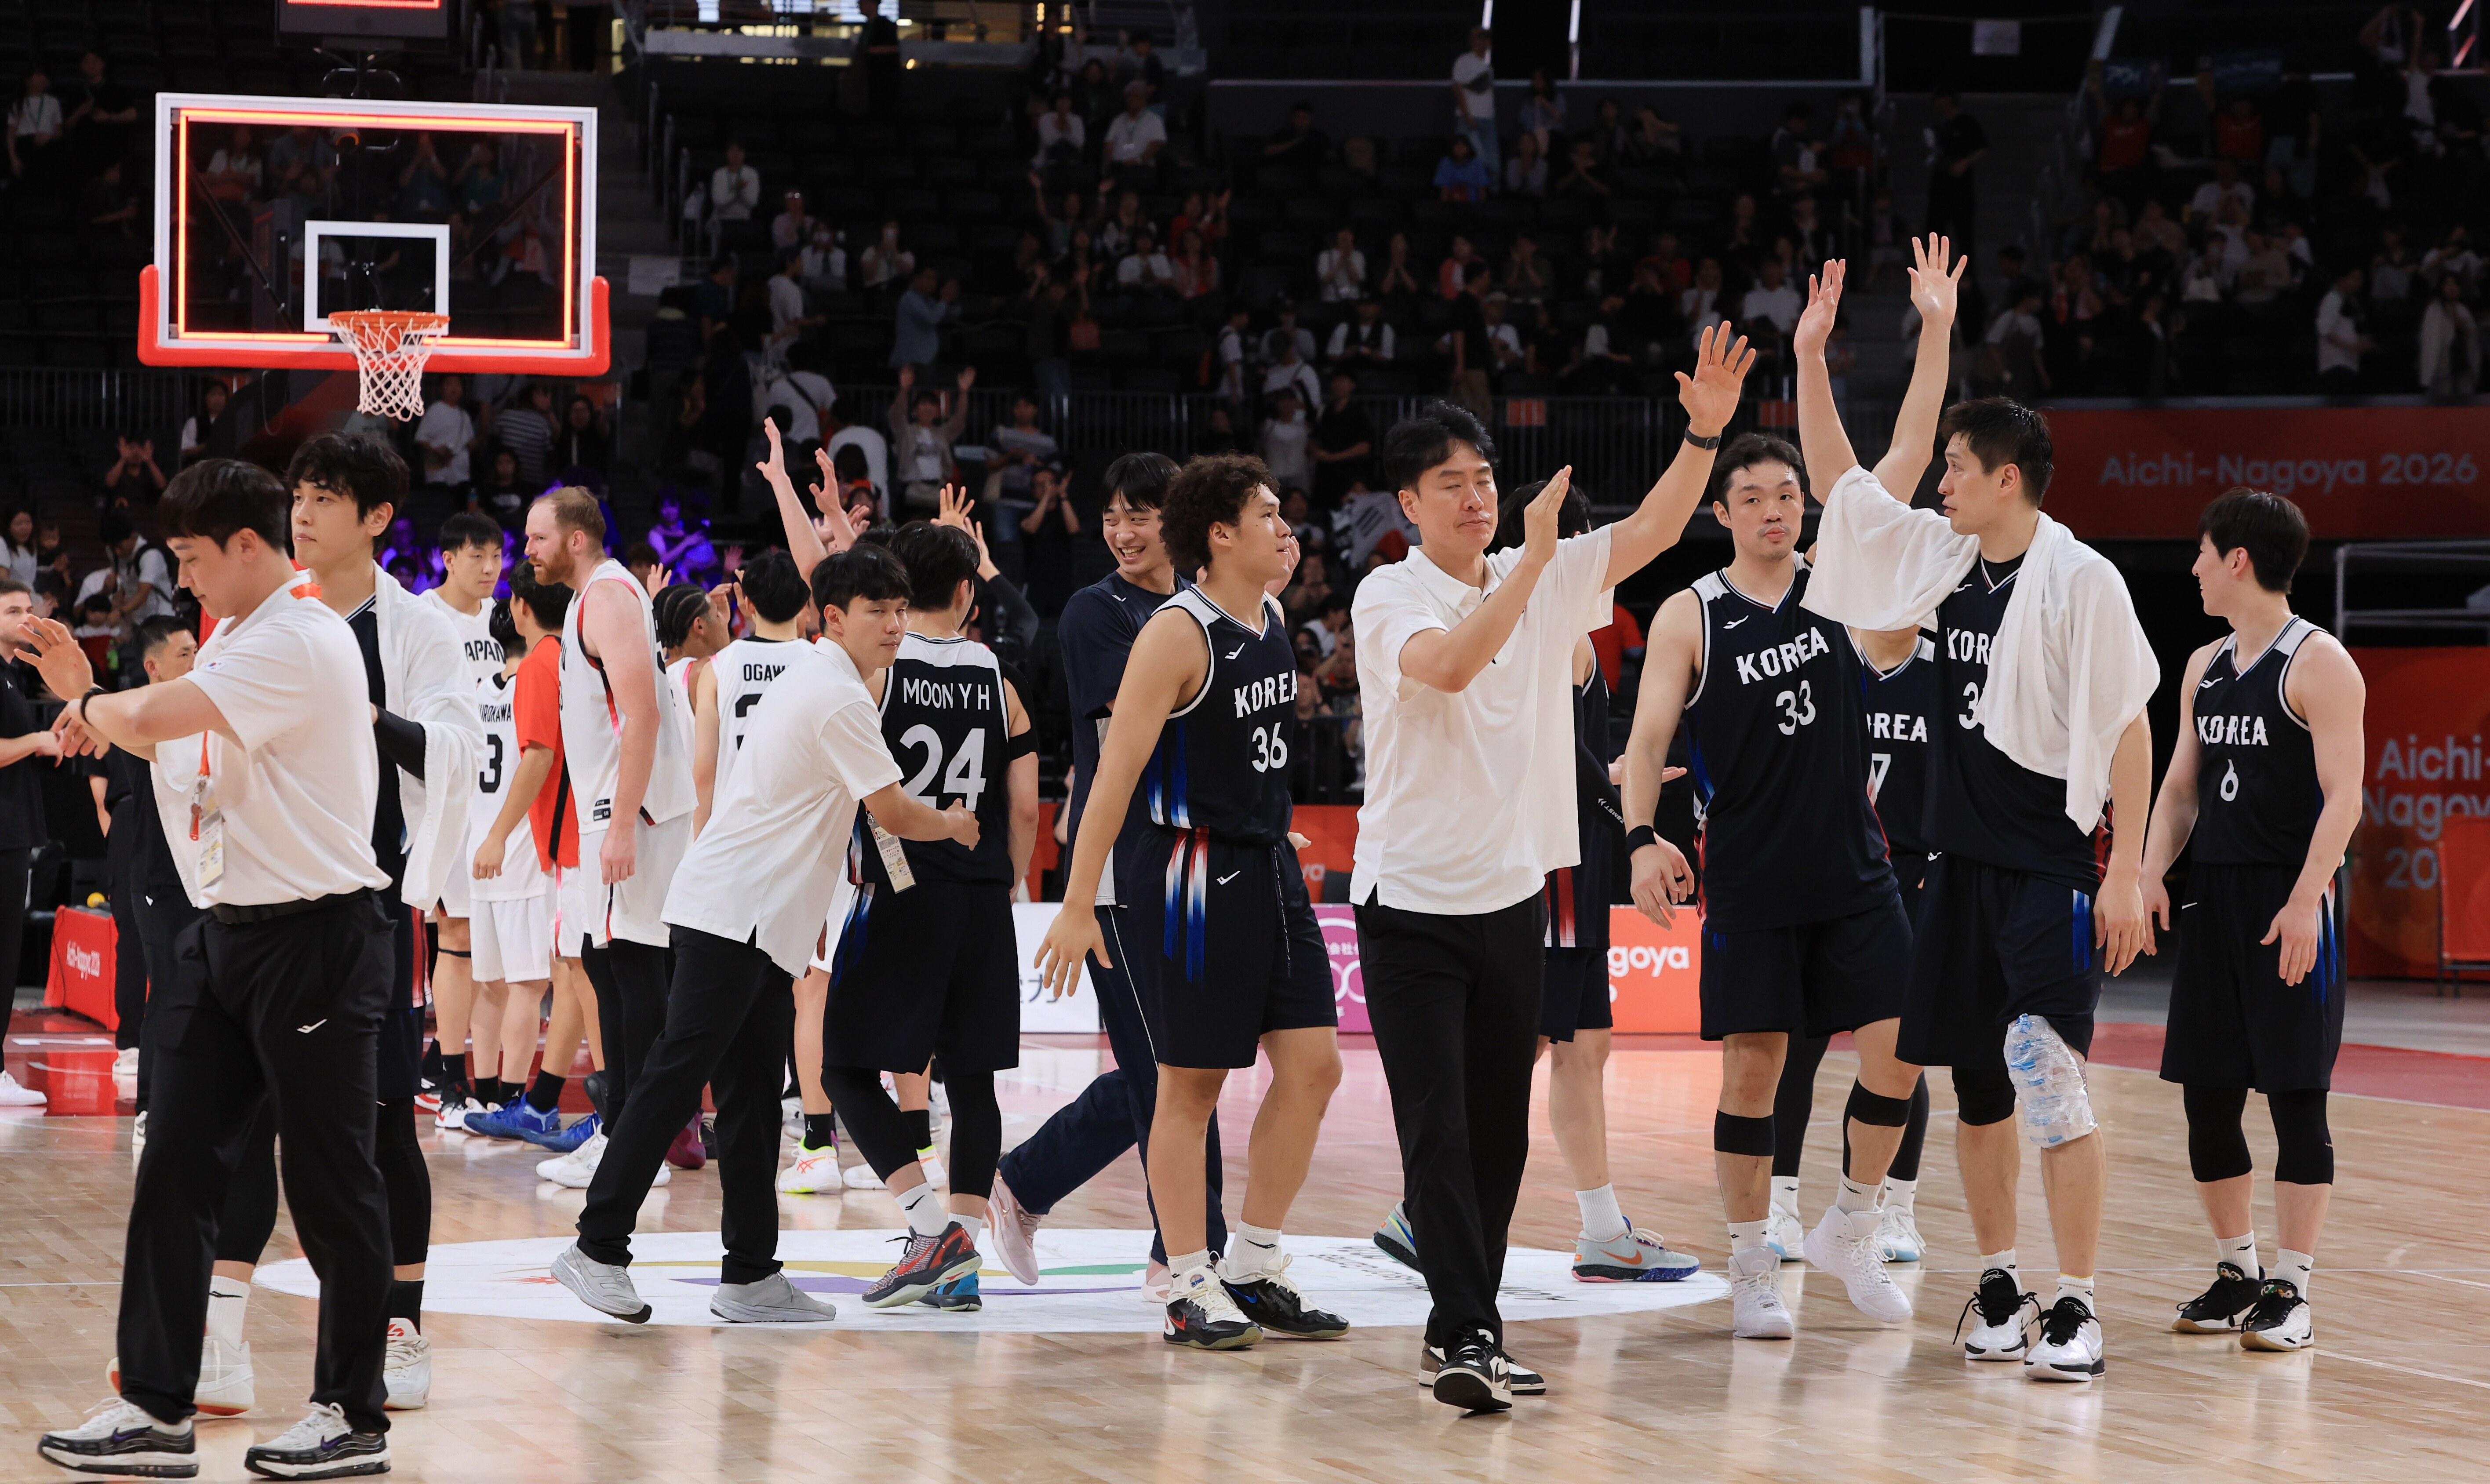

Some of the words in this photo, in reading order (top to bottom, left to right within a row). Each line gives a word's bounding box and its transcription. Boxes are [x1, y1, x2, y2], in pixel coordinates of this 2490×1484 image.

[2100, 452, 2367, 495] Aichi-Nagoya
[2379, 452, 2478, 484] 2026
[465, 640, 506, 665] APAN
[1736, 626, 1830, 685] KOREA
[1947, 627, 1989, 665] KOR
[743, 663, 789, 682] OGAW
[903, 677, 954, 709] MOON
[1234, 669, 1298, 718] KOREA
[478, 703, 511, 723] UROKAWA
[1776, 680, 1816, 735] 33
[1959, 682, 1984, 730] 3
[1252, 722, 1288, 773] 36
[1866, 713, 1928, 743] REA
[2197, 715, 2269, 746] KOREA
[899, 724, 987, 812] 24
[2220, 759, 2239, 802] 6
[2384, 847, 2439, 889] 20
[1607, 945, 1690, 978] goya
